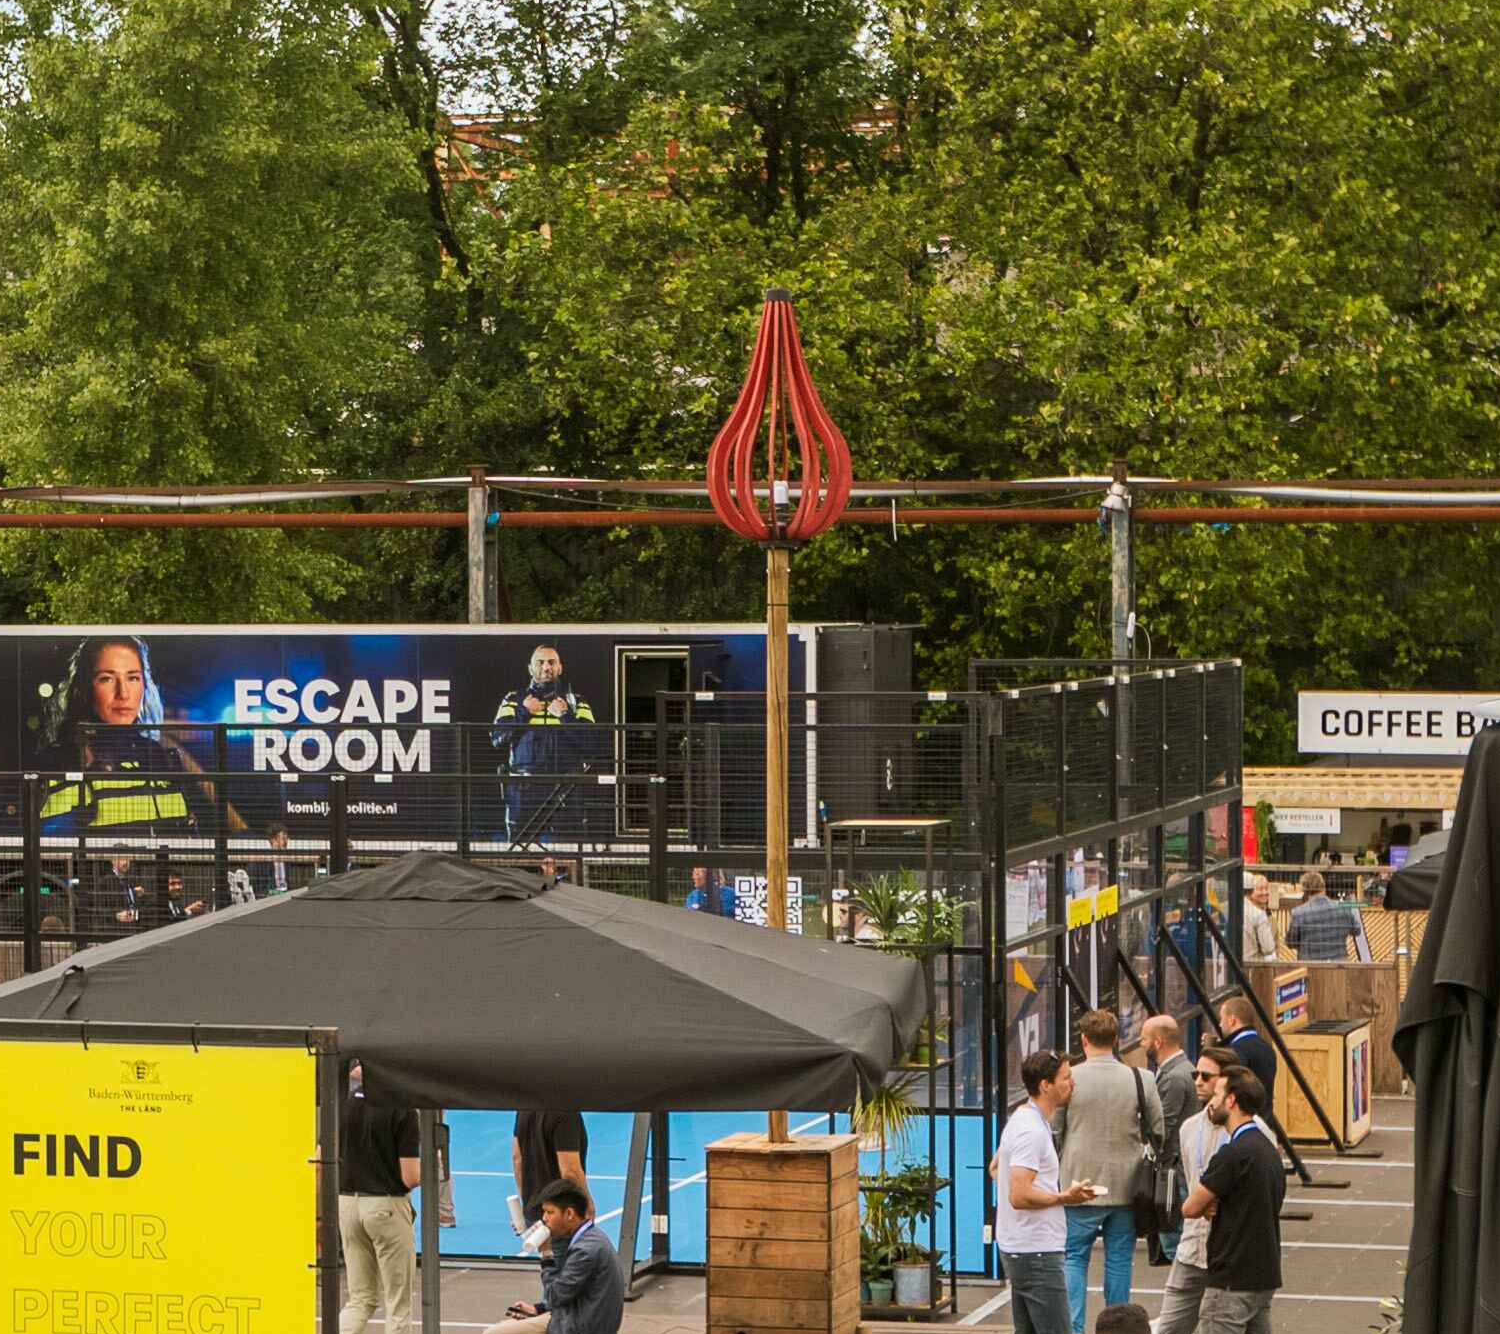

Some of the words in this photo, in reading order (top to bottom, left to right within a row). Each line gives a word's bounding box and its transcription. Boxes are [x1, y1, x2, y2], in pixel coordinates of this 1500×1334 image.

[234, 678, 451, 724] ESCAPE
[1321, 709, 1442, 738] COFFEE
[253, 728, 431, 773] ROOM
[88, 1087, 194, 1105] Baden-Württemberg
[119, 1105, 136, 1113] THE
[13, 1133, 142, 1179] FIND
[10, 1210, 168, 1260] YOUR
